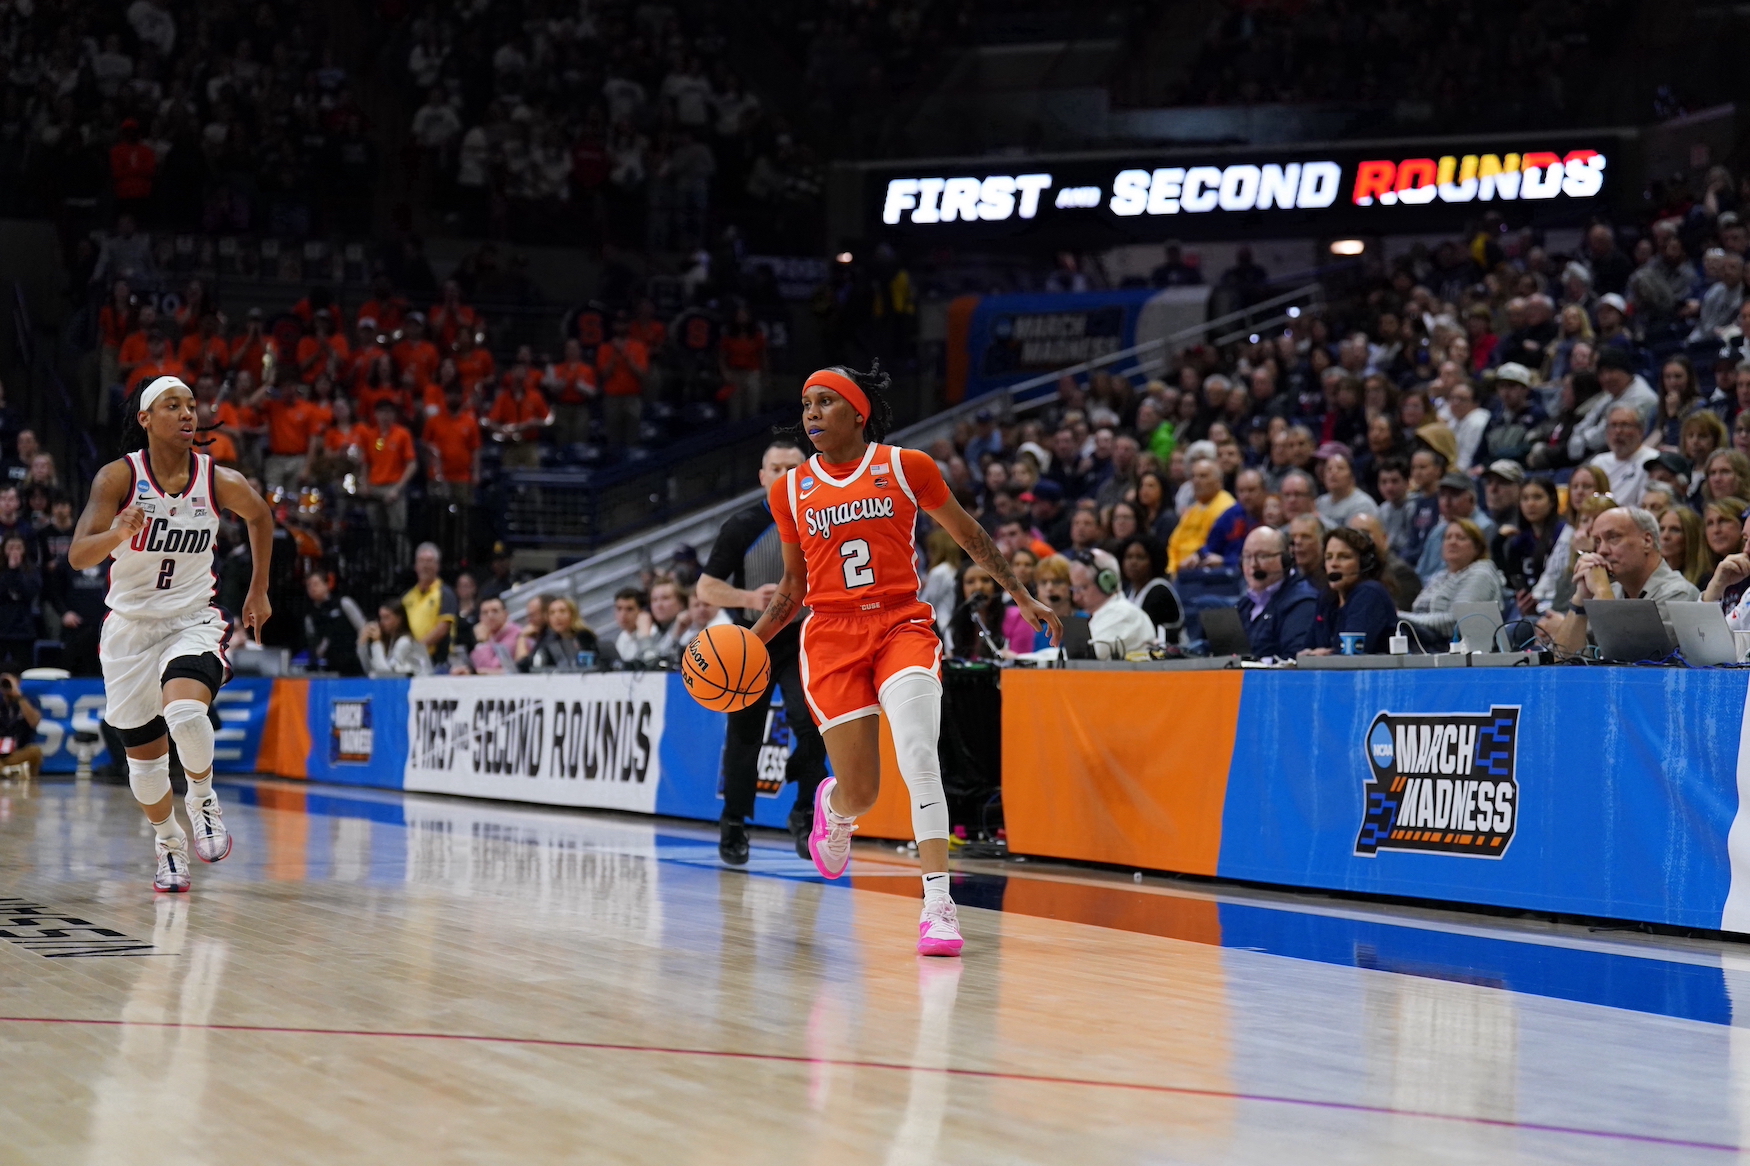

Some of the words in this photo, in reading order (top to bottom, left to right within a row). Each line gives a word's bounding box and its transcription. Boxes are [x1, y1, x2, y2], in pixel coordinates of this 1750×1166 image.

[883, 173, 1052, 224] FIRST
[1110, 160, 1342, 217] SECOND
[1352, 150, 1606, 206] ROUNDS
[804, 495, 895, 539] Syracuse
[156, 558, 176, 590] 2
[839, 538, 875, 590] 2
[472, 697, 545, 777] SECOND
[548, 700, 652, 784] ROUNDS
[1373, 743, 1393, 757] NCAA
[1395, 724, 1477, 775] MARCH
[1396, 778, 1514, 834] MADNESS
